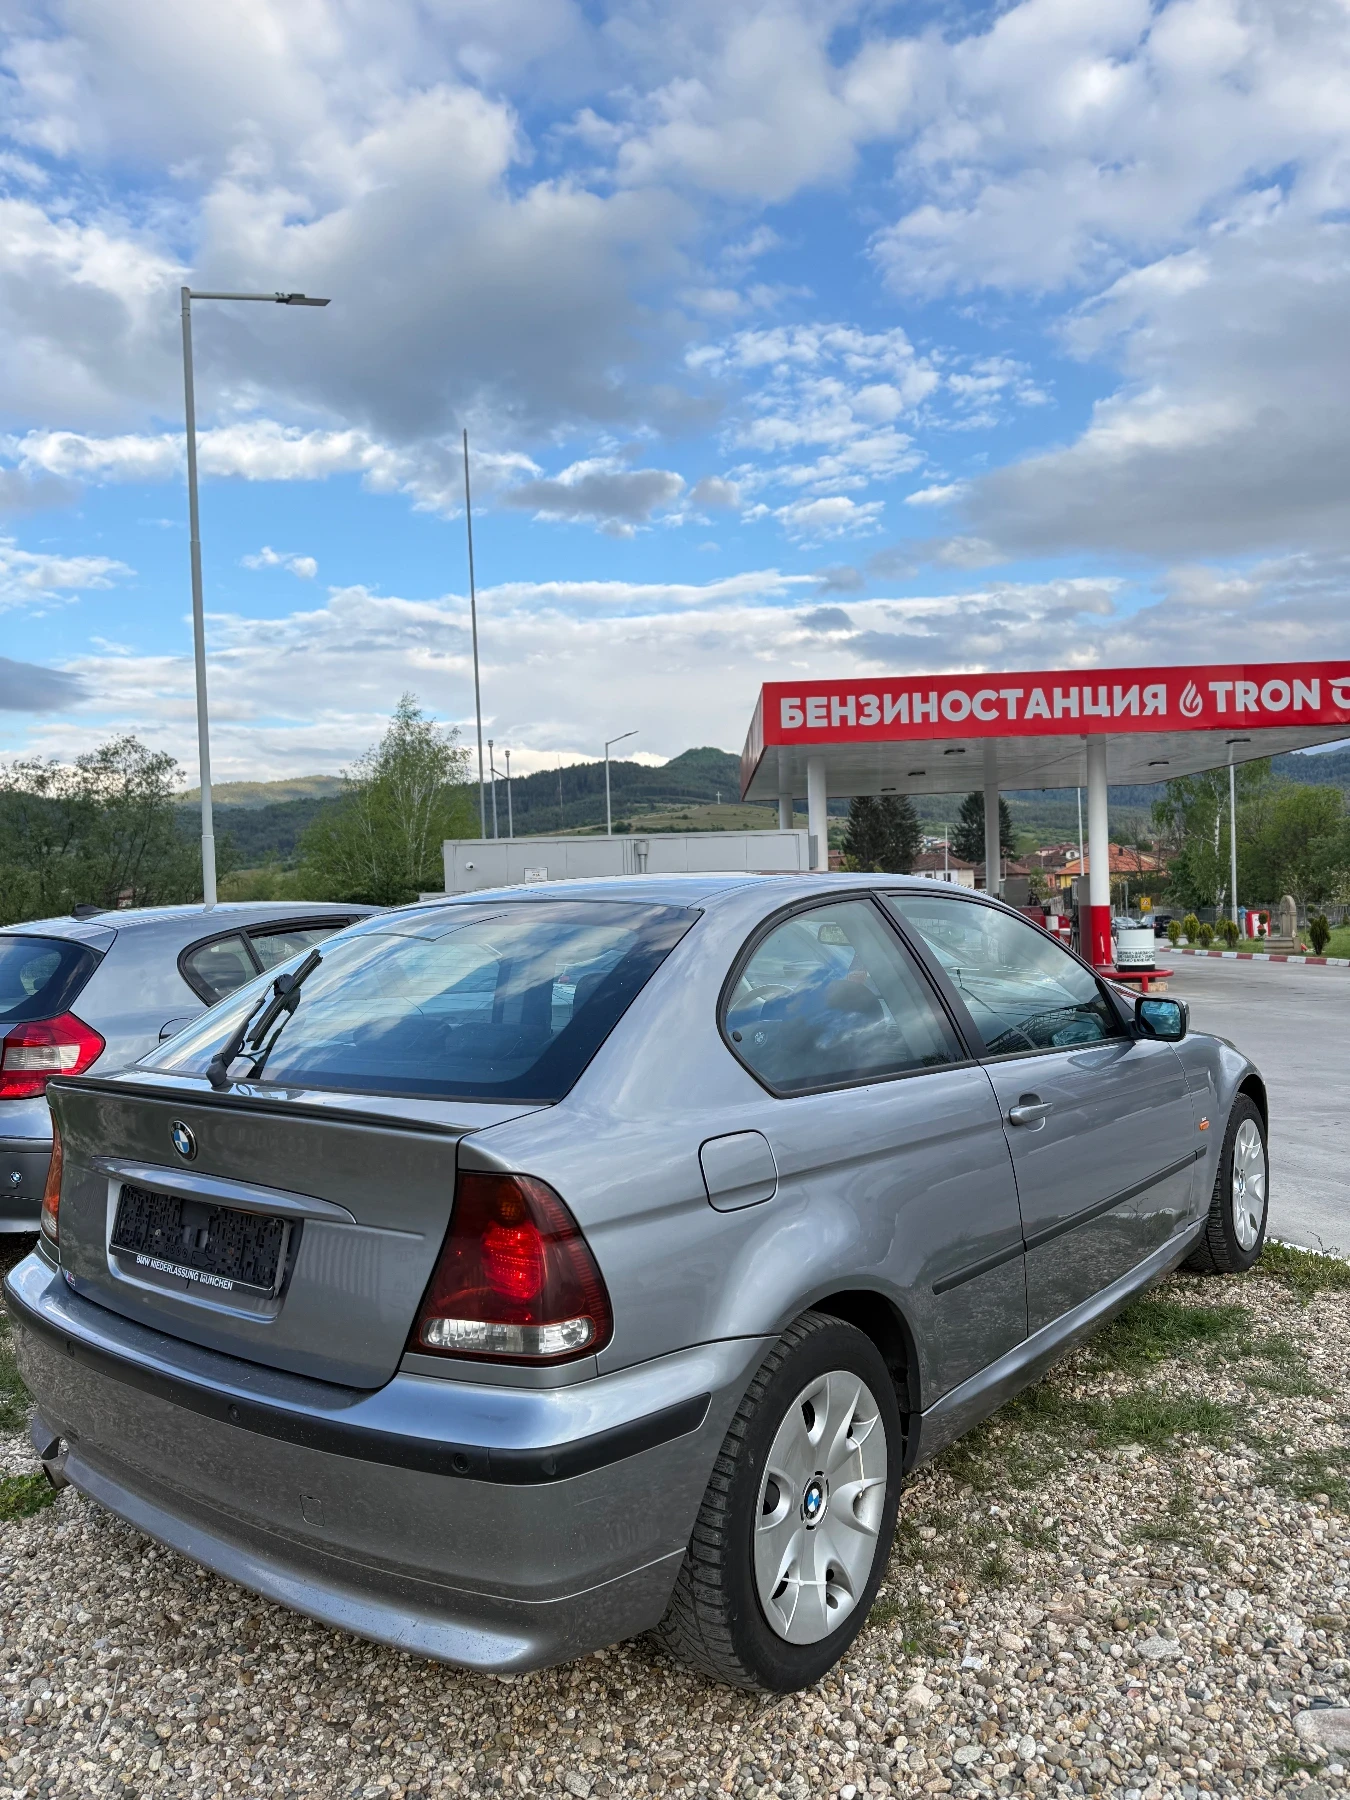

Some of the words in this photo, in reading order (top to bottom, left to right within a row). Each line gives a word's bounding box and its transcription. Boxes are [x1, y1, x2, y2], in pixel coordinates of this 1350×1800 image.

[780, 683, 1168, 729] БЕНЗИНОСТАНЦИЯ
[1209, 678, 1321, 713] TRON
[136, 1254, 150, 1267] BMW
[150, 1258, 199, 1281] NIEDERLASSUNG
